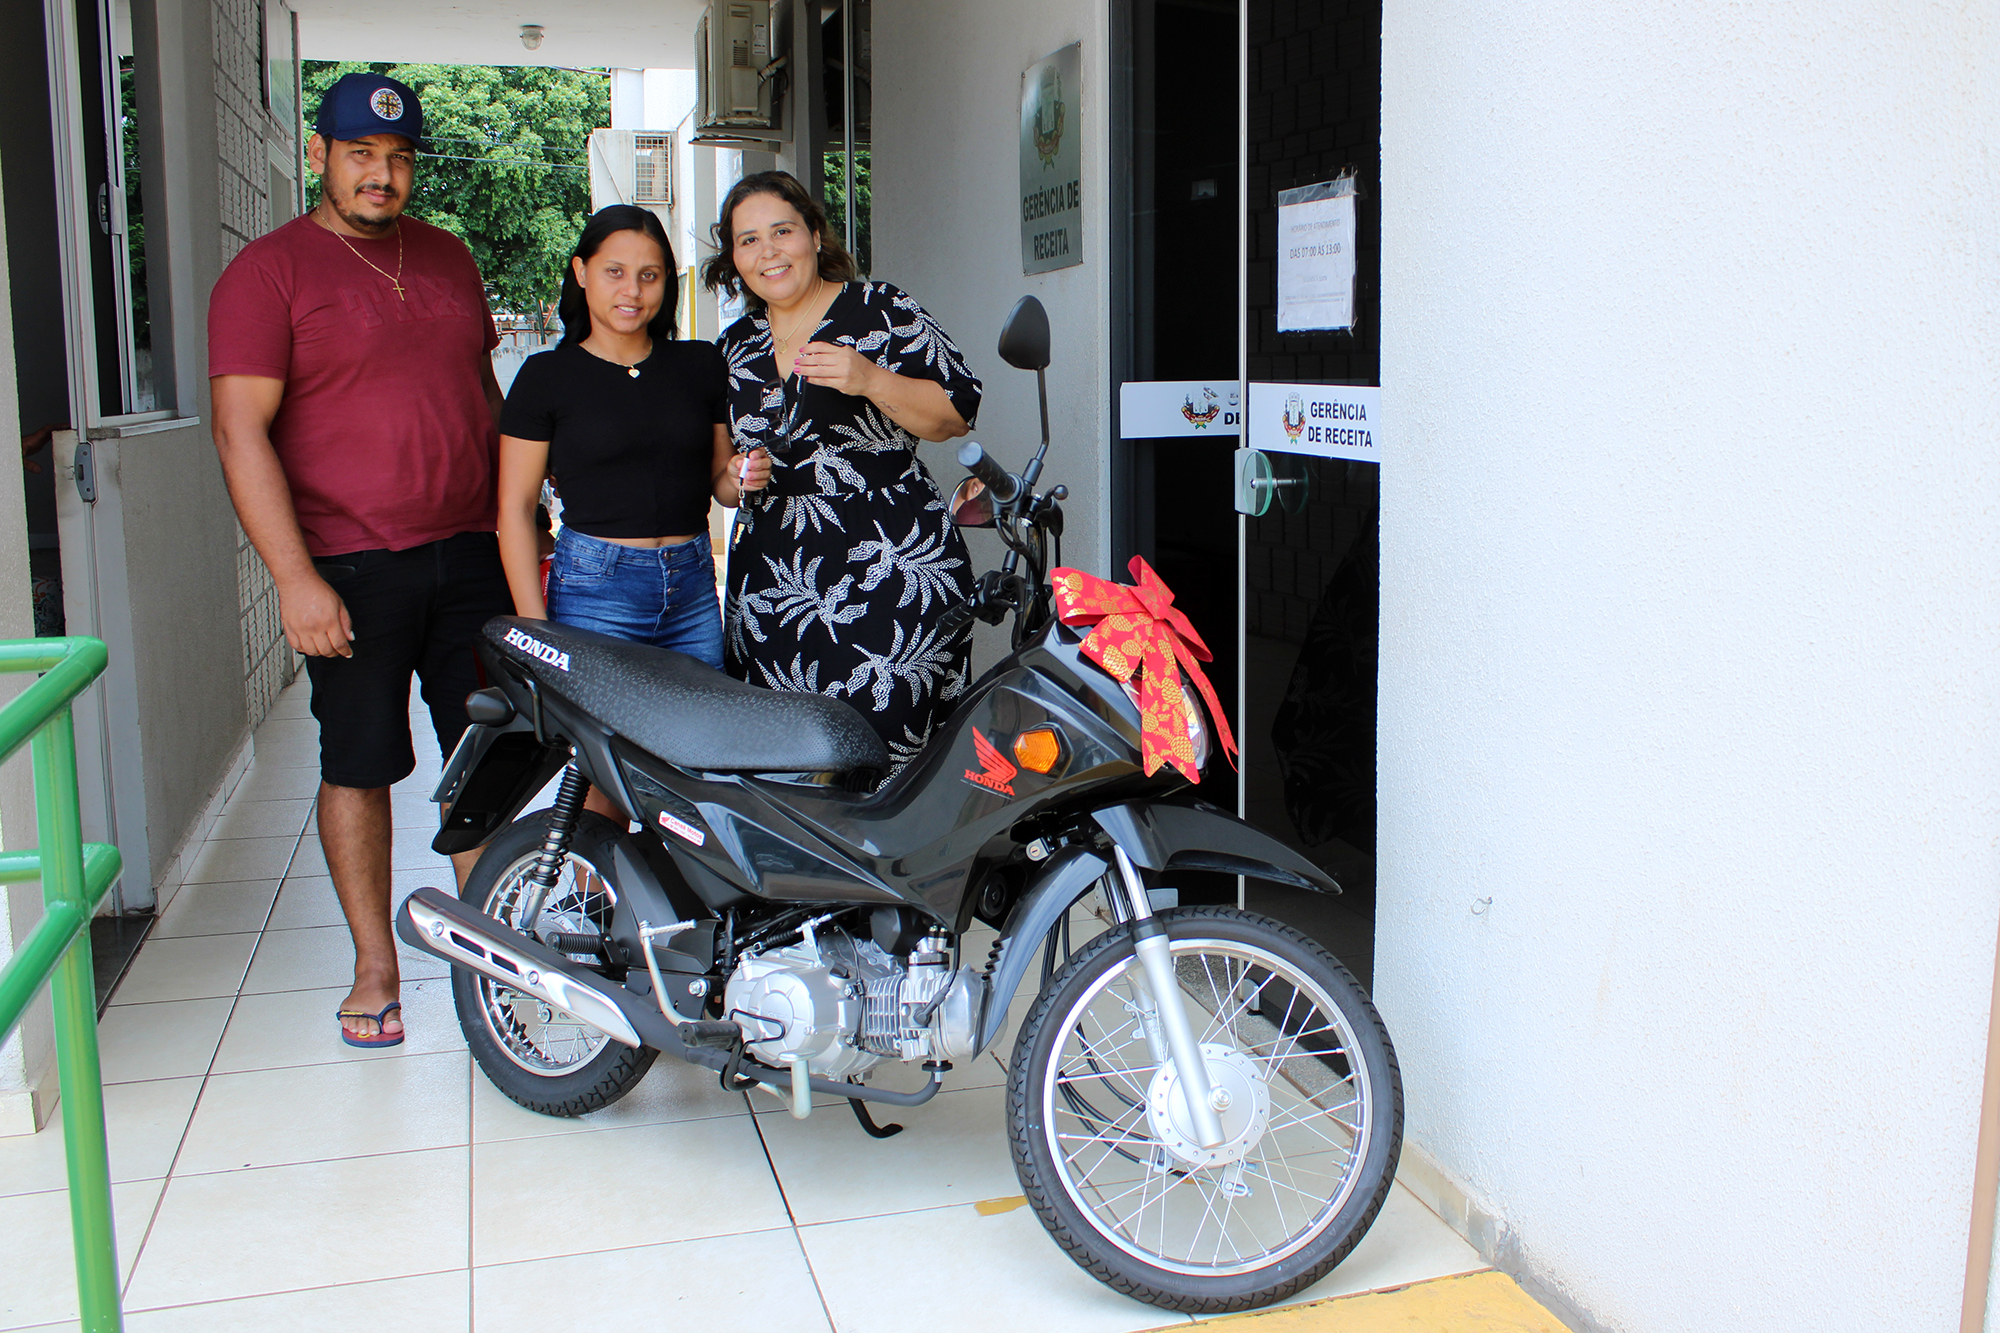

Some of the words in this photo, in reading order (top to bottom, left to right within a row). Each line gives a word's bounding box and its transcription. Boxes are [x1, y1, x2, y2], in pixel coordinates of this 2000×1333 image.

[1023, 185, 1065, 222] GERÊNCIA
[1067, 180, 1079, 210] DE
[1034, 228, 1069, 260] RECEITA
[1290, 248, 1300, 259] DAS
[1302, 246, 1316, 258] 07:00
[1326, 243, 1341, 255] 13:00
[1310, 398, 1367, 421] GERÊNCIA
[1308, 426, 1322, 443] DE
[1325, 427, 1373, 447] RECEITA
[503, 626, 571, 672] HONDA
[964, 769, 1016, 796] HONDA
